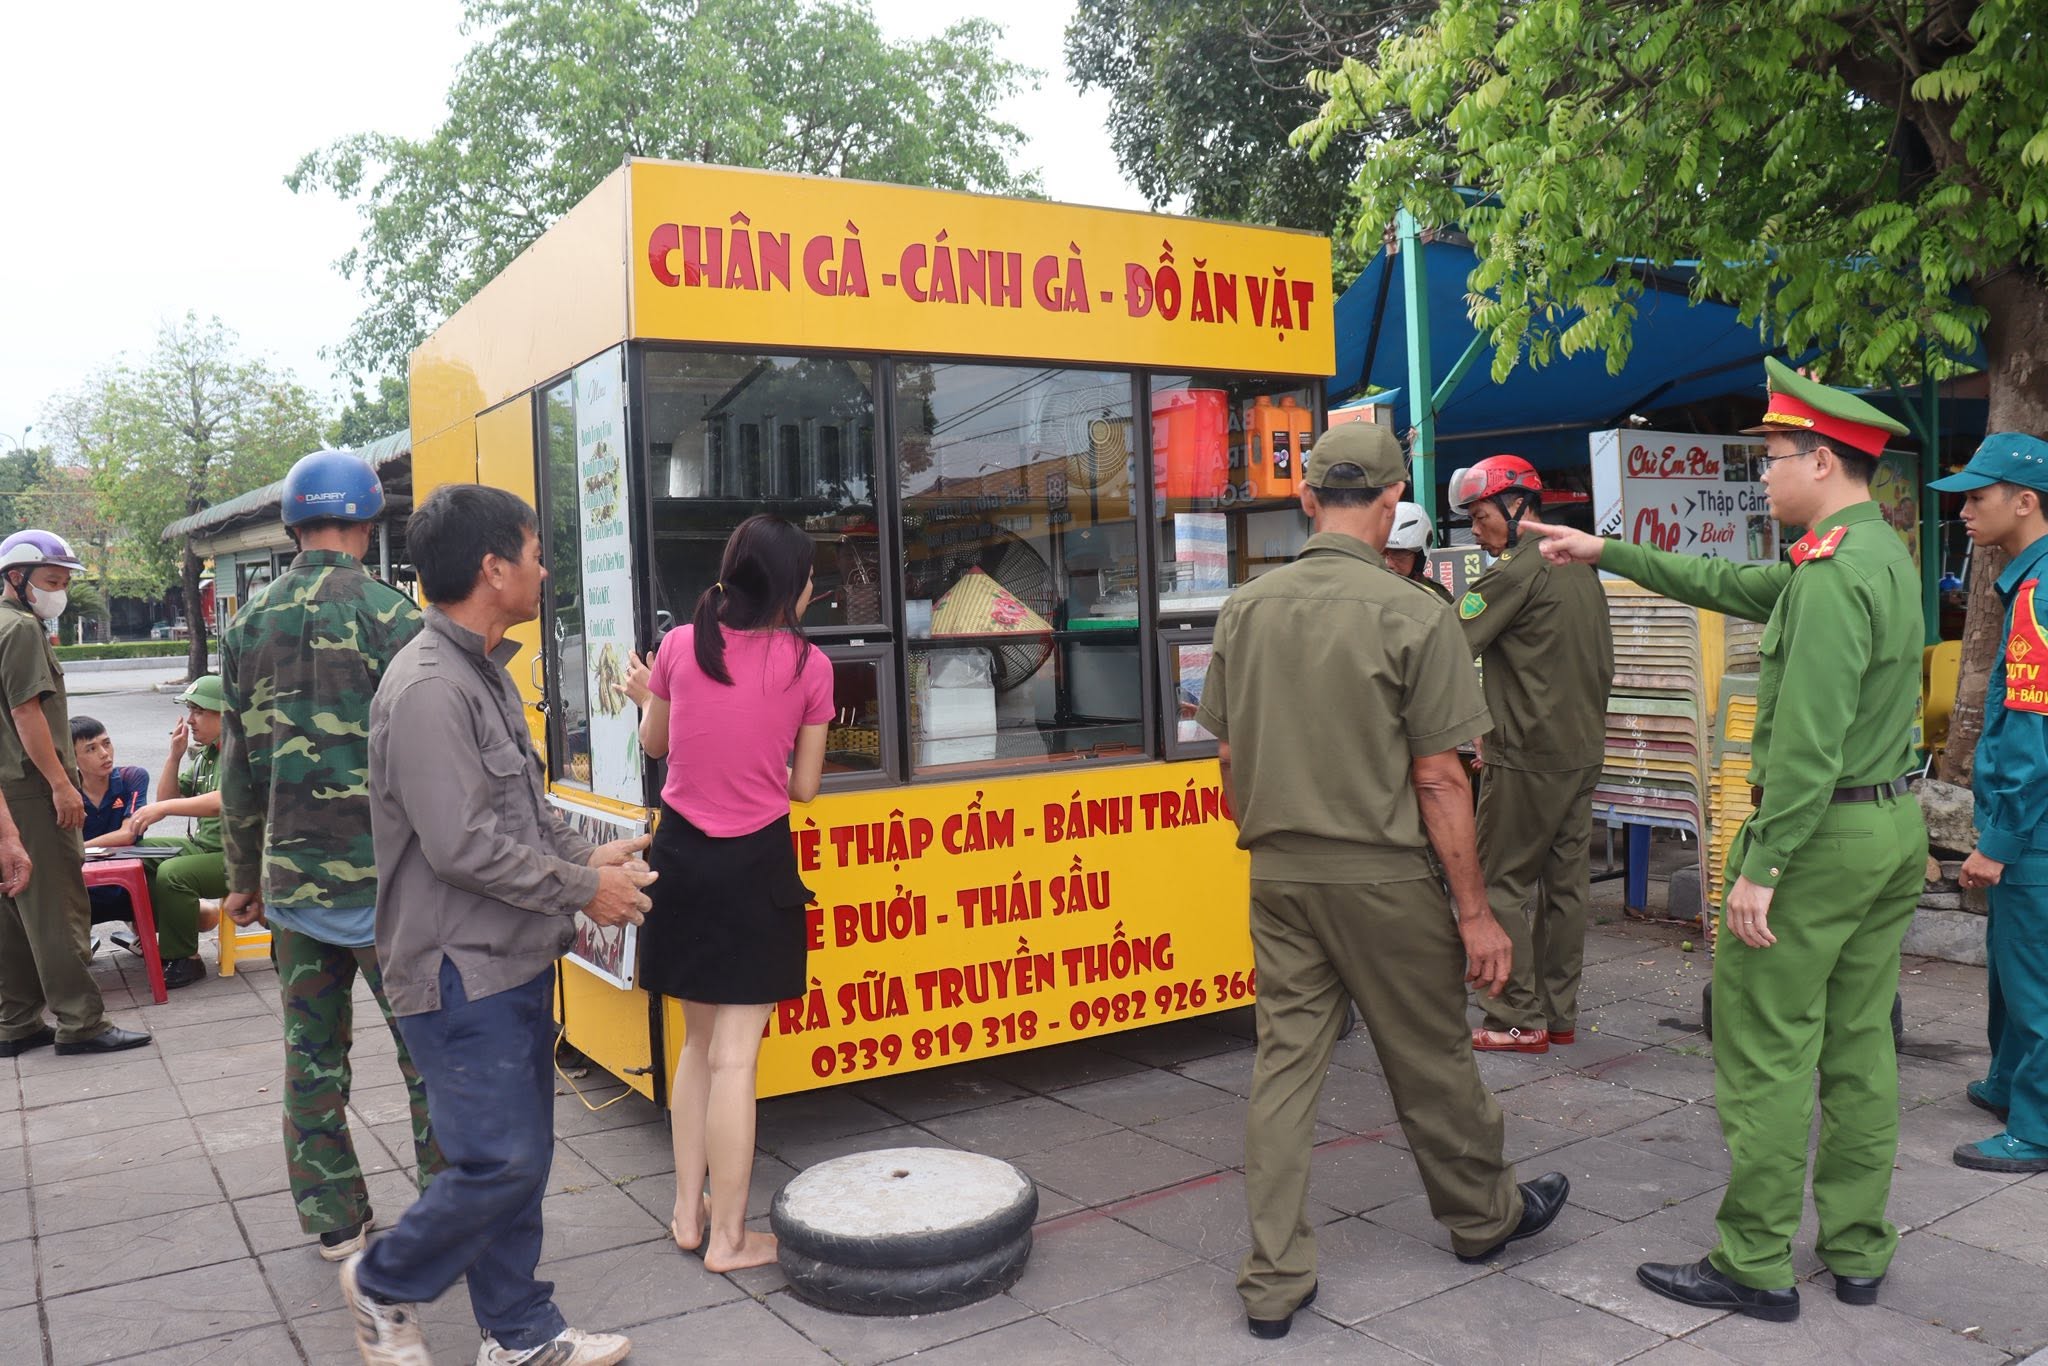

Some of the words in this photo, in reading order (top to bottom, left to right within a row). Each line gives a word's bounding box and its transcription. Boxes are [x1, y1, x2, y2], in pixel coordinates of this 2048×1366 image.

[648, 212, 790, 291] CHÂN
[803, 221, 869, 297] GÀ
[900, 230, 1022, 308] CÁNH
[1033, 243, 1089, 313] GÀ
[1125, 240, 1181, 321] ĐỒ
[1191, 259, 1237, 324] ĂN
[1245, 268, 1314, 341] VẶT
[1627, 445, 1657, 477] Chè
[1659, 446, 1686, 477] Em
[1698, 490, 1734, 517] Thập
[1701, 522, 1736, 543] Bưởi
[830, 808, 933, 872] THẬP
[942, 791, 1014, 855] CẨM
[1044, 790, 1133, 843] BÁNH
[957, 870, 1041, 928] THÁI
[1049, 855, 1110, 916] SẦU
[837, 970, 909, 1025] SỮA
[915, 936, 1055, 1012] TRUYỀN
[1061, 921, 1174, 987] THỐNG
[811, 1034, 902, 1078] 0339
[912, 1022, 973, 1060] 819
[982, 1010, 1038, 1048] 318
[1070, 990, 1146, 1031] 0982
[1154, 979, 1207, 1014] 926
